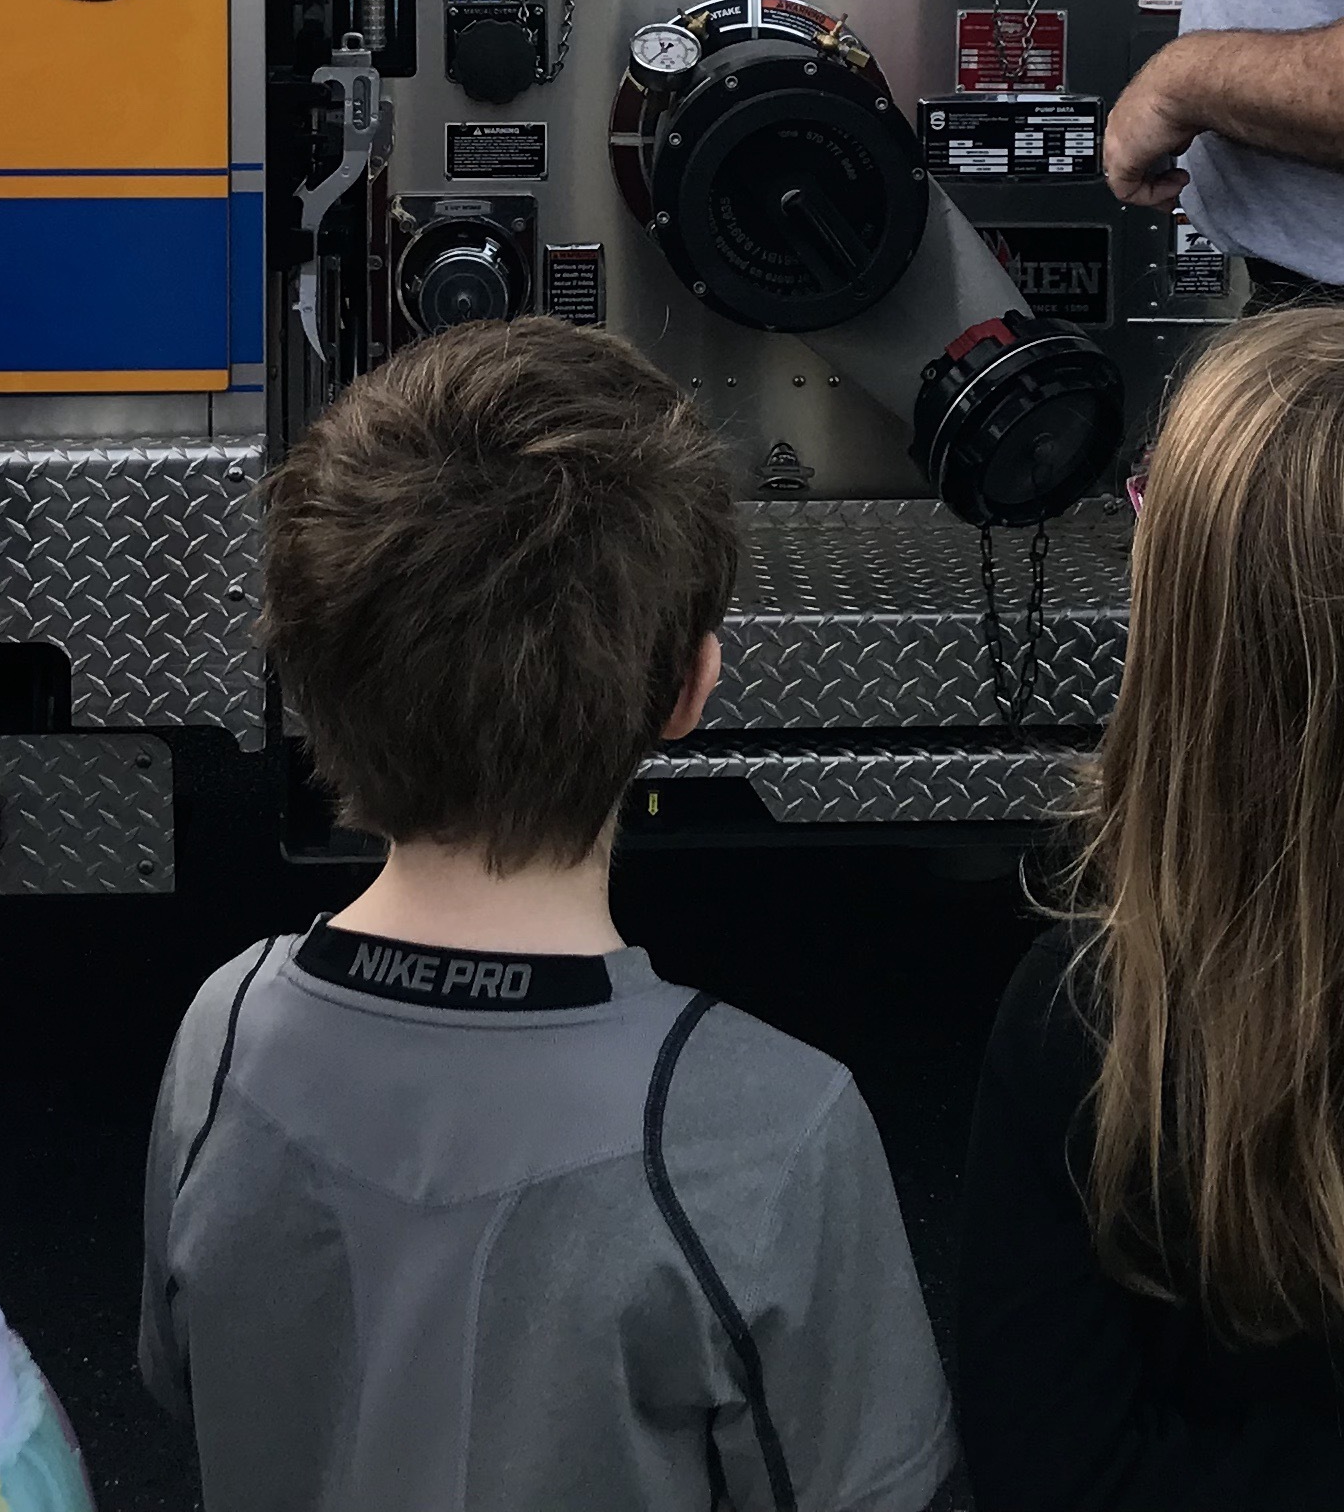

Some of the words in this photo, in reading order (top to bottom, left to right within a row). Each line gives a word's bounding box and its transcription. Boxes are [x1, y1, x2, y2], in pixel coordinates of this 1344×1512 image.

[1008, 261, 1102, 294] HEN
[348, 942, 442, 991] NIKE
[441, 960, 533, 1001] PRO
